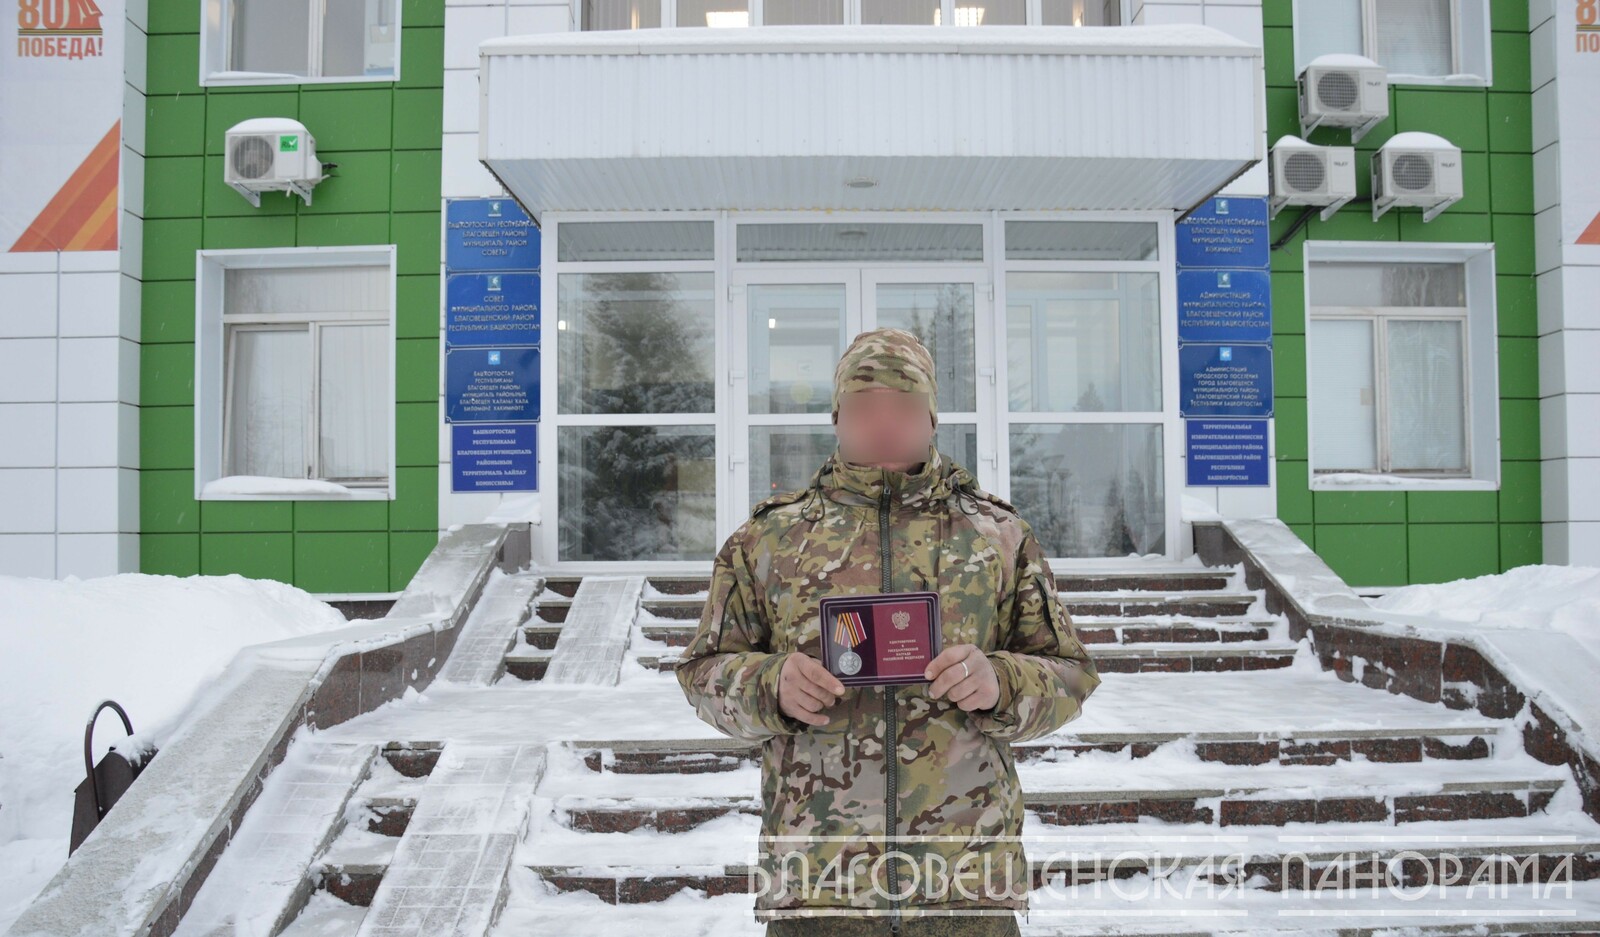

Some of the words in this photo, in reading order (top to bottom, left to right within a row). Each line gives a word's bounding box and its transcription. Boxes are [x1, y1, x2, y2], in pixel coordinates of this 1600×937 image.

[18, 0, 63, 28] 80
[1576, 33, 1600, 53] ПО
[18, 37, 103, 60] ПОБЕДА!
[483, 295, 504, 303] СОВЕТ
[1200, 291, 1251, 299] АДМИНИСТРАЦИЯ
[451, 304, 509, 312] МУНИЦИПАЛЬНОГО
[454, 314, 511, 322] БЛАГОВЕЩЕНСКИЙ
[512, 313, 535, 321] РАЙОН
[1186, 310, 1241, 318] БЛАГОВЕЩЕНСКИЙ
[1243, 310, 1264, 318] РАЙОН
[448, 324, 488, 332] РЕСПУБЛИКИ
[490, 323, 540, 331] БАШКОРТОСТАН
[1222, 320, 1270, 328] БАШКОРТОСТАН
